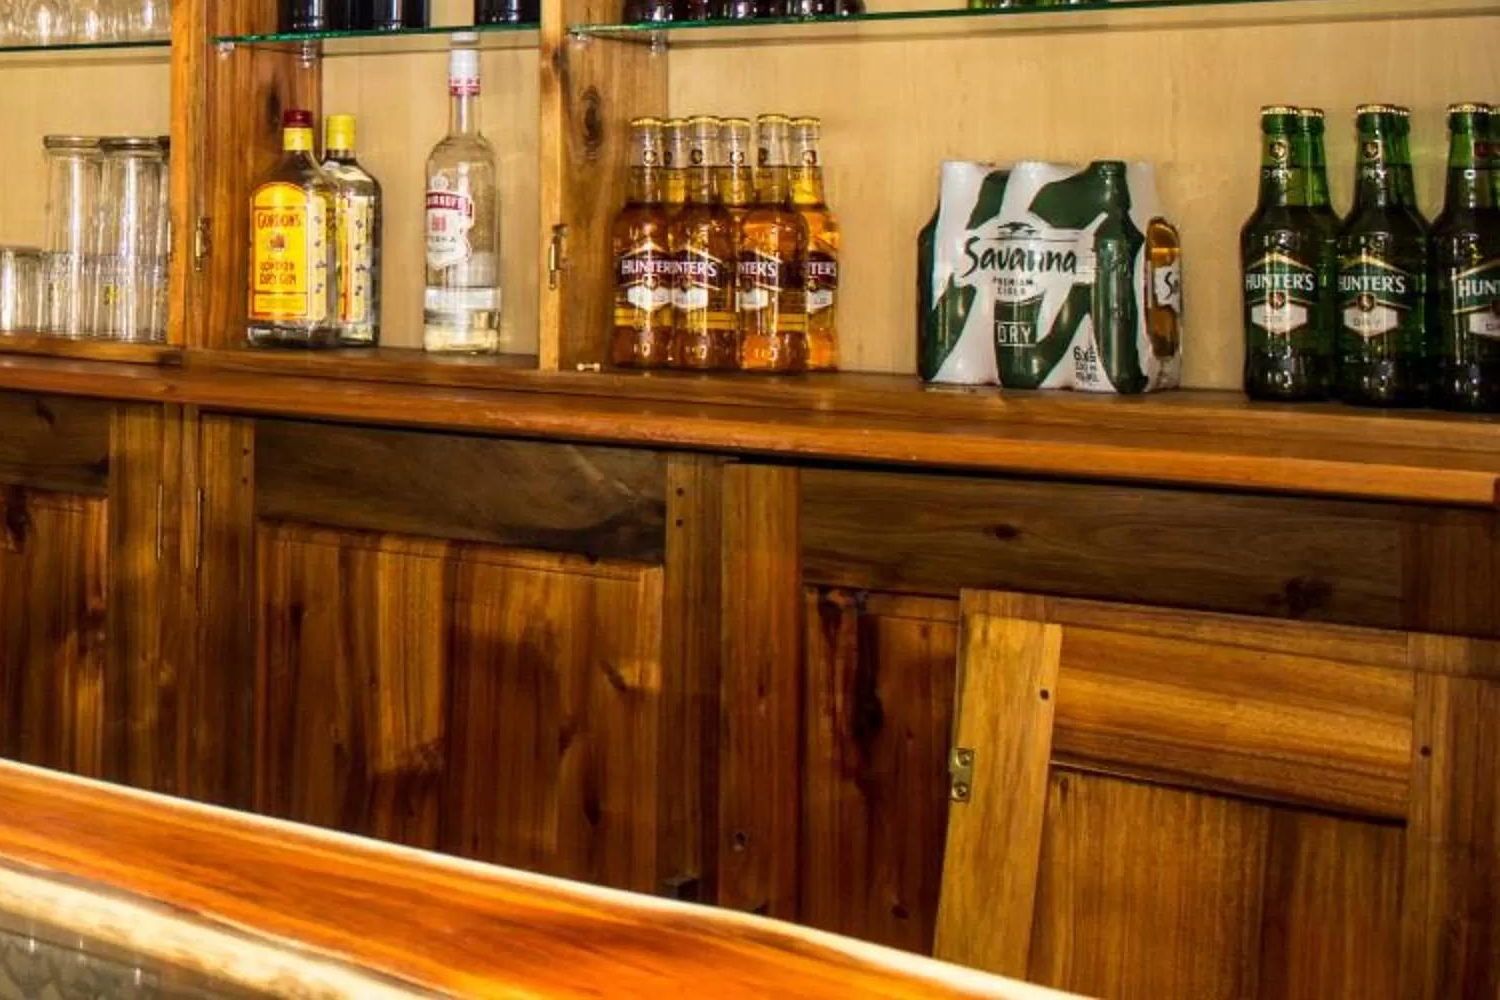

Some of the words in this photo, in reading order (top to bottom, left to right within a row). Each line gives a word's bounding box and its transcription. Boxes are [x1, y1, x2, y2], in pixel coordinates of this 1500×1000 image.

[960, 236, 1077, 278] Savanna
[1245, 273, 1314, 291] HUNTER'S
[1337, 274, 1406, 294] HUNTER'S
[997, 324, 1032, 345] DRY
